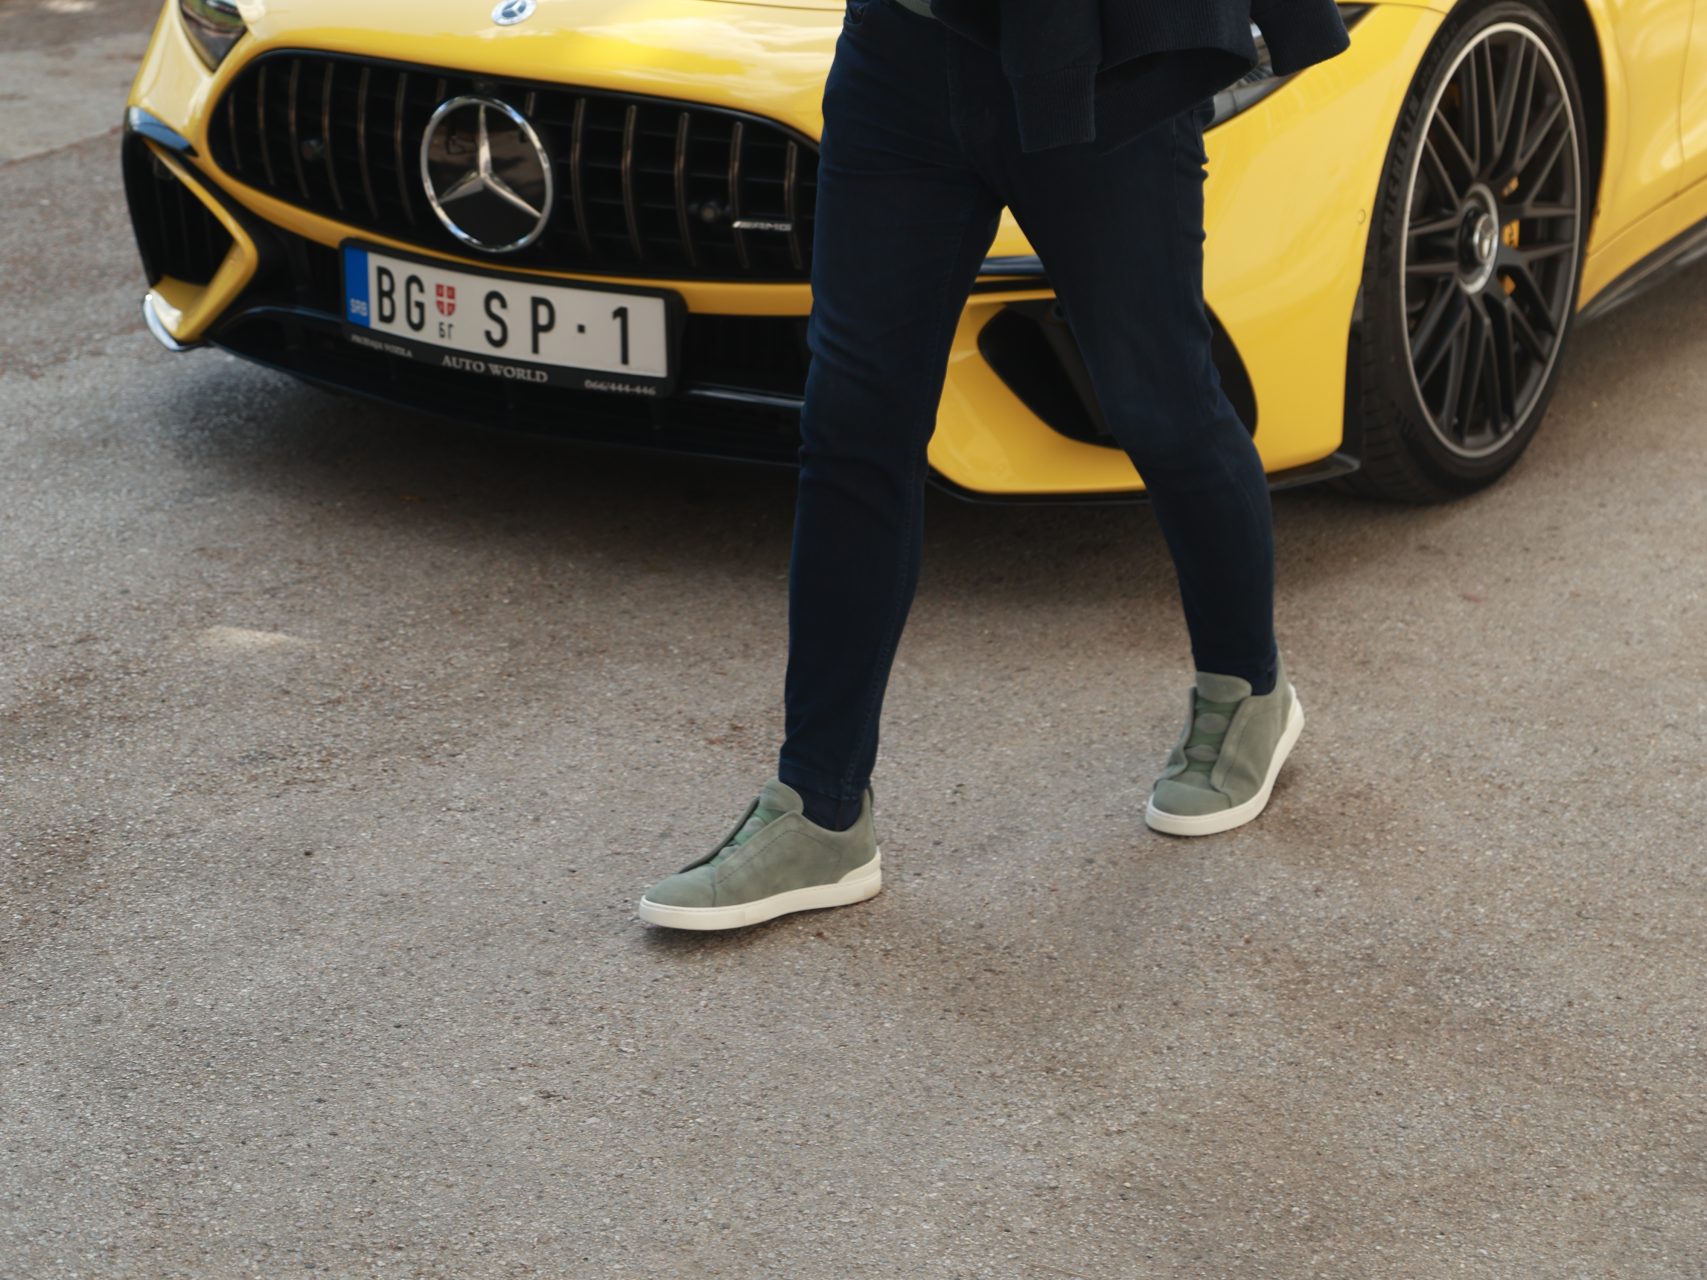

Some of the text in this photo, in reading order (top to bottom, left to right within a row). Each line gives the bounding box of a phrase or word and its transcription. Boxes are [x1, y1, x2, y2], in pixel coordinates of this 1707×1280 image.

[350, 298, 368, 317] SRB
[376, 265, 426, 332] BG
[441, 355, 549, 383] AUTO WORLD
